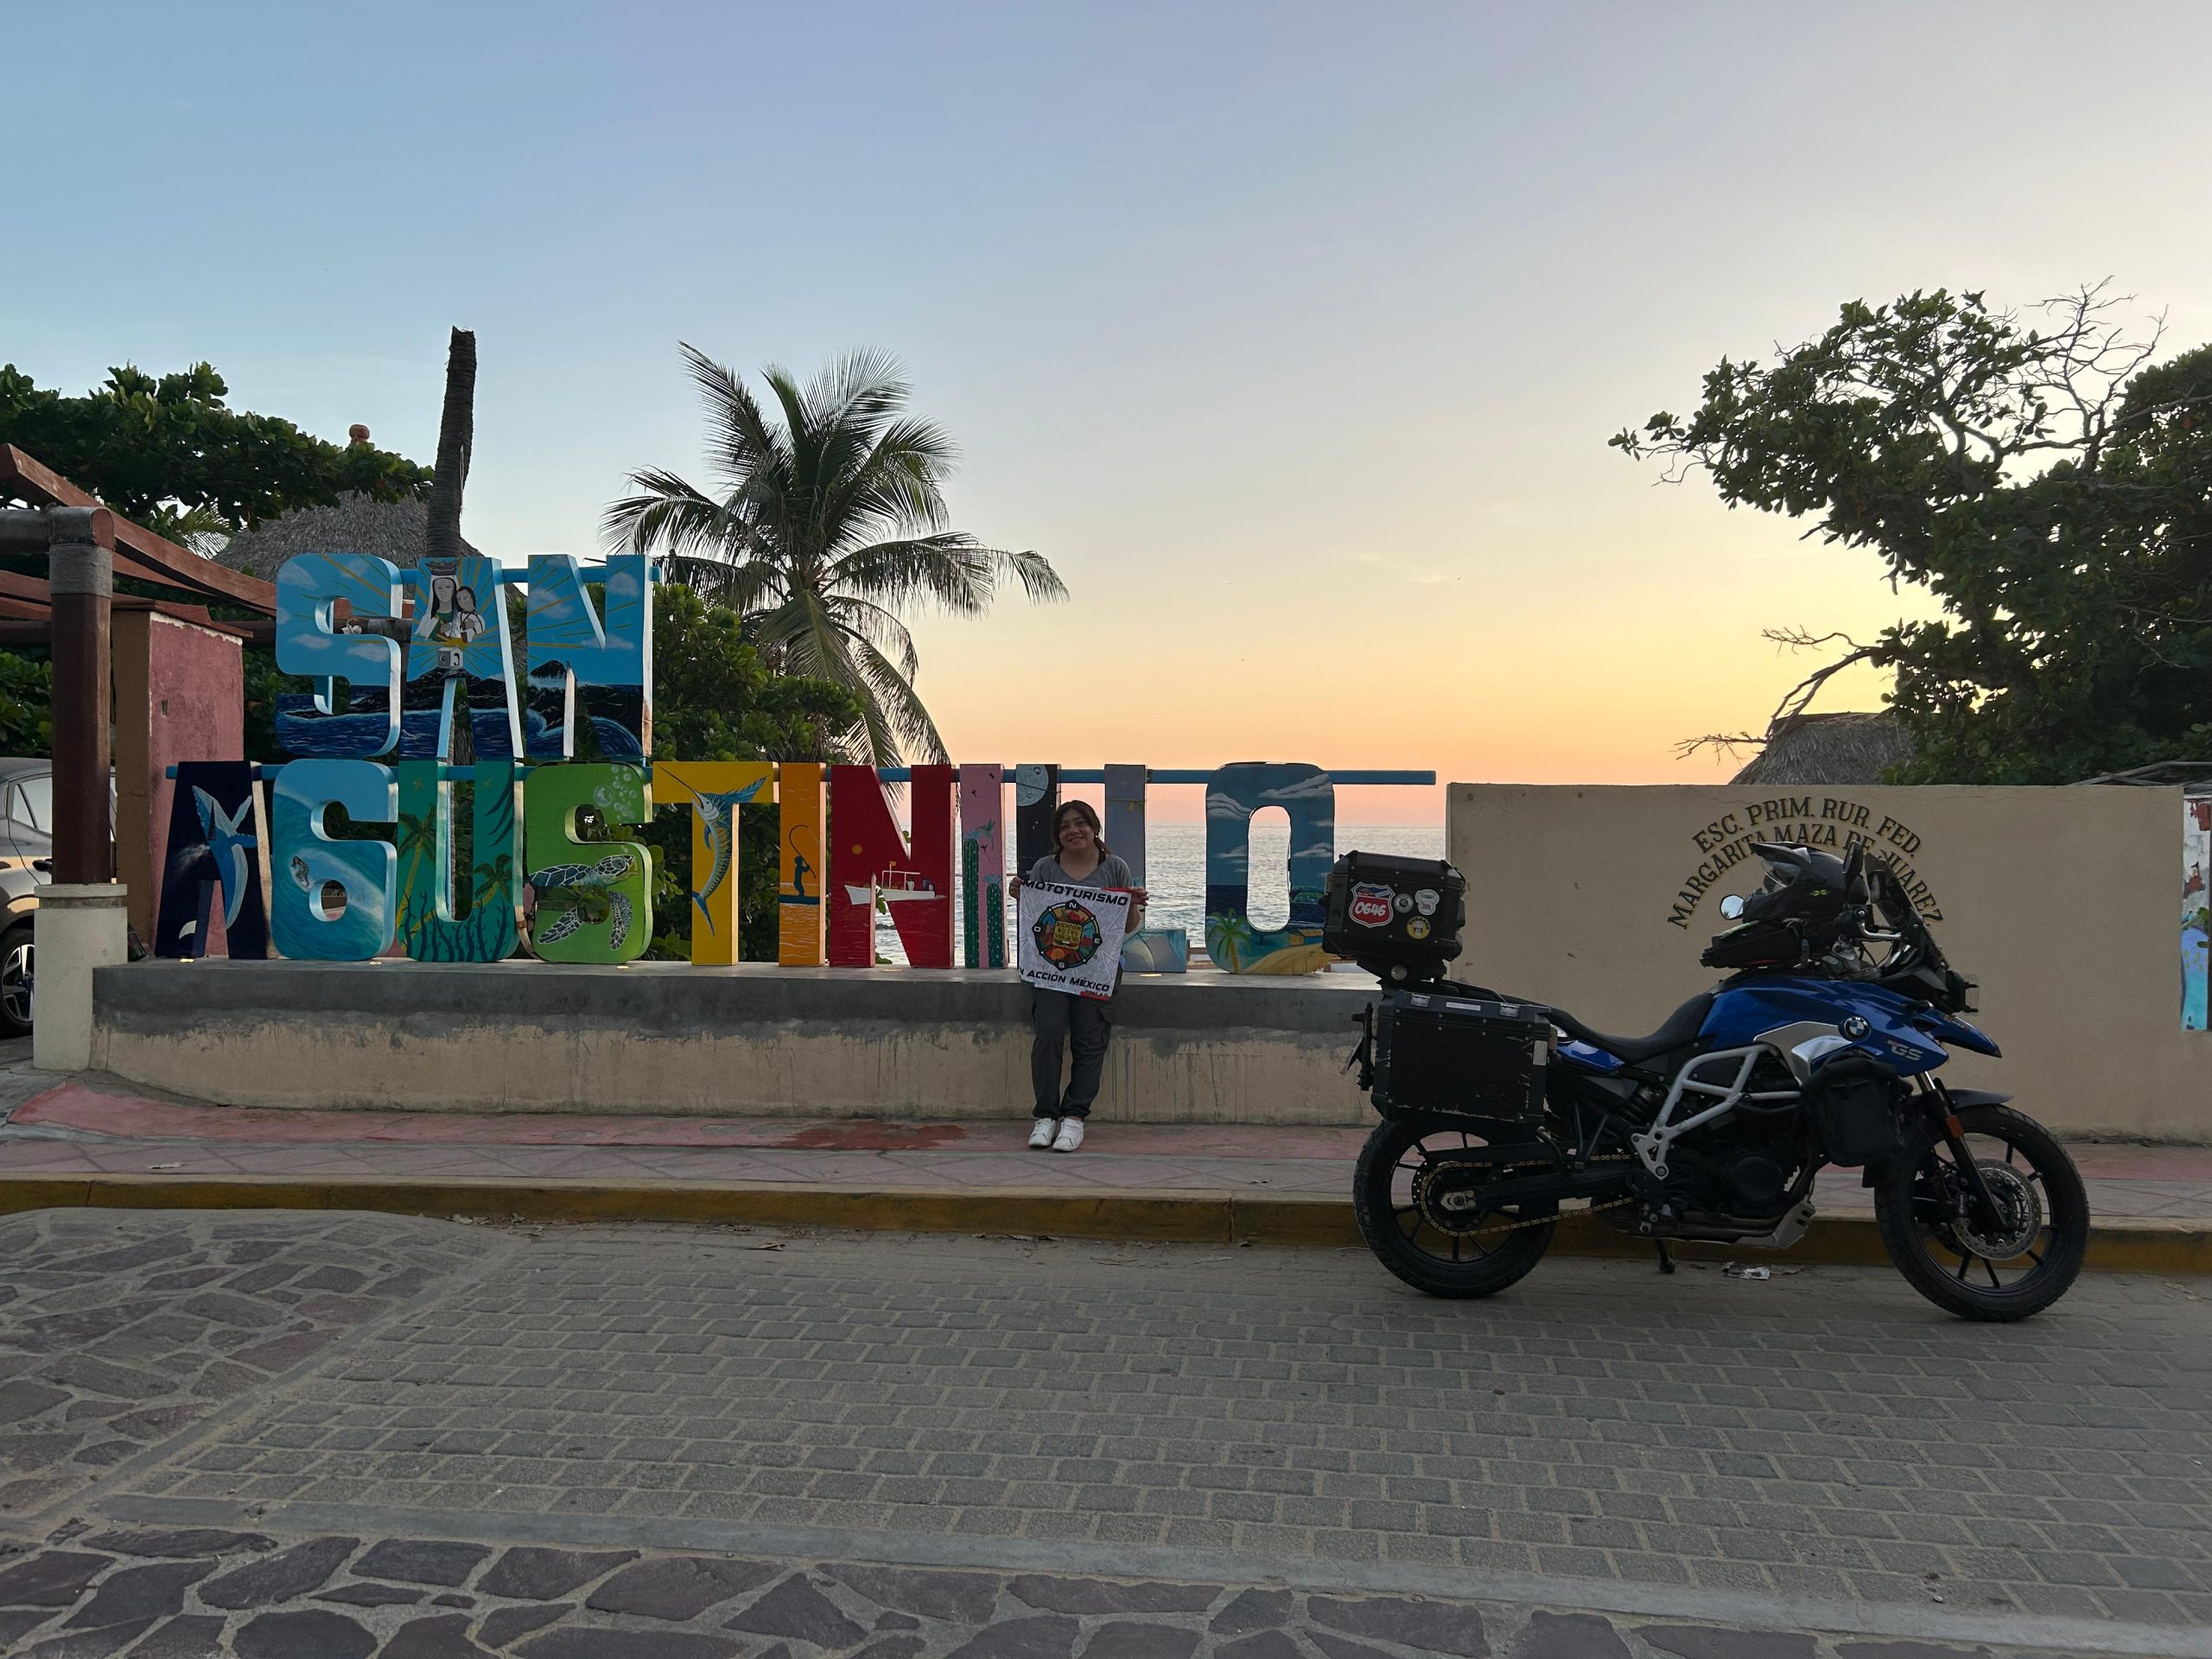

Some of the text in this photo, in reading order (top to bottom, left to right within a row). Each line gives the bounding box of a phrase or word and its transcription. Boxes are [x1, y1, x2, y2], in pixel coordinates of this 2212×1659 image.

[276, 553, 653, 759] SAN
[1691, 796, 1922, 858] ESC. PRIM. RUR. FED.
[1021, 880, 1128, 906] MOTOTURISMO
[1668, 830, 1766, 931] MARGARITA
[1773, 823, 1837, 847] MAZA
[1842, 830, 1876, 856] DE
[1027, 969, 1066, 983] ACCIÓN
[1070, 977, 1110, 992] MÉXICO
